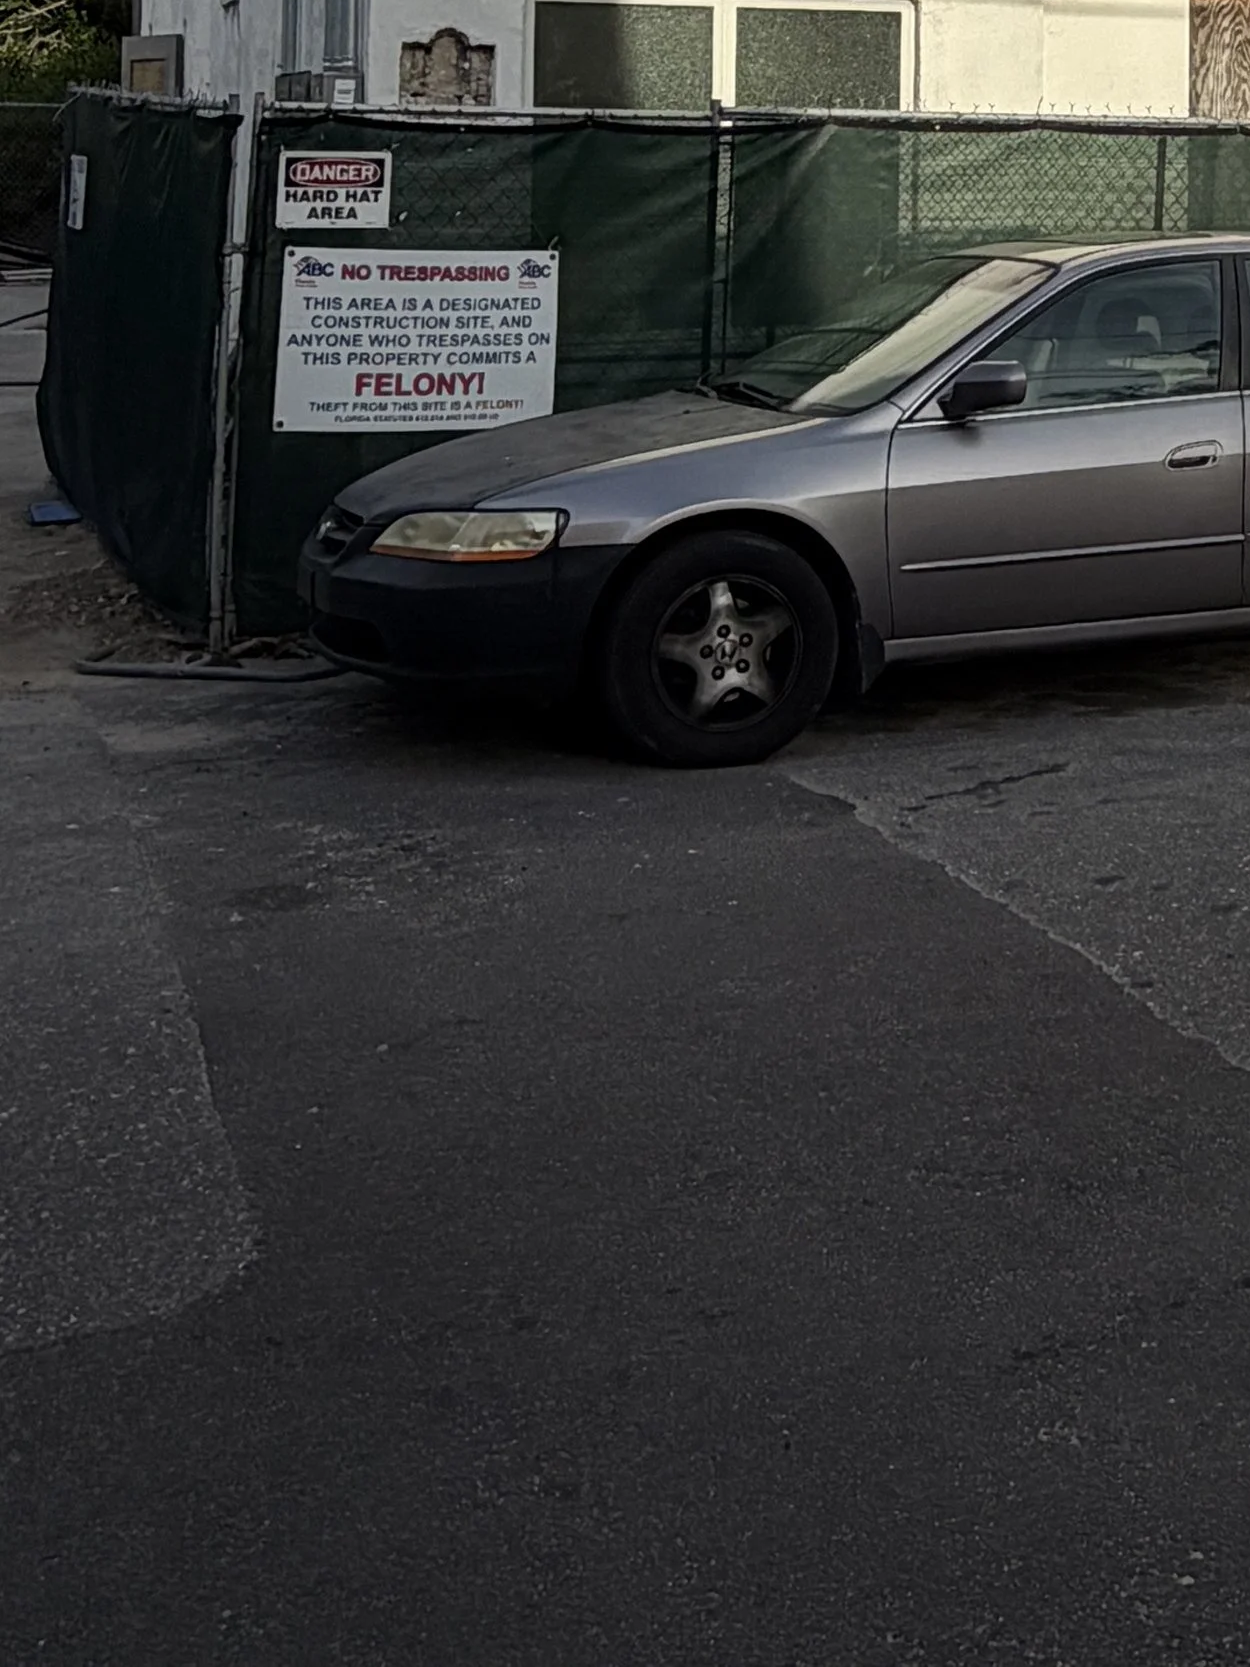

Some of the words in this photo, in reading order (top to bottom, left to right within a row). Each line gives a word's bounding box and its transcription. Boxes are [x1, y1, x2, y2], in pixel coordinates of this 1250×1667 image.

[296, 164, 374, 181] DANGER
[284, 189, 338, 203] HARD
[345, 189, 382, 203] HAT
[306, 206, 358, 220] AREA
[296, 261, 334, 276] ABC
[340, 263, 372, 280] NO
[376, 264, 510, 282] TRESPASSING
[519, 264, 551, 278] ABC
[303, 296, 343, 310] THIS
[347, 298, 397, 311] AREA
[402, 298, 417, 311] IS
[421, 298, 434, 311] A
[439, 297, 542, 311] DESIGNATED
[311, 315, 450, 329] CONSTRUCTION
[455, 315, 495, 330] SITE,
[499, 315, 532, 329] AND
[286, 334, 363, 347] ANYONE
[368, 334, 411, 348] WHO
[416, 333, 523, 347] TRESPASSES
[528, 332, 550, 346] ON
[301, 352, 341, 365] THIS
[347, 352, 441, 366] PROPERTY
[446, 351, 521, 365] COMMITS
[525, 350, 537, 363] A
[355, 372, 485, 397] FELONY!
[309, 401, 349, 412] THEFT
[352, 401, 388, 412] FROM
[391, 401, 418, 411] THIS
[421, 400, 447, 411] SITE
[450, 400, 460, 411] IS
[463, 400, 472, 410] A
